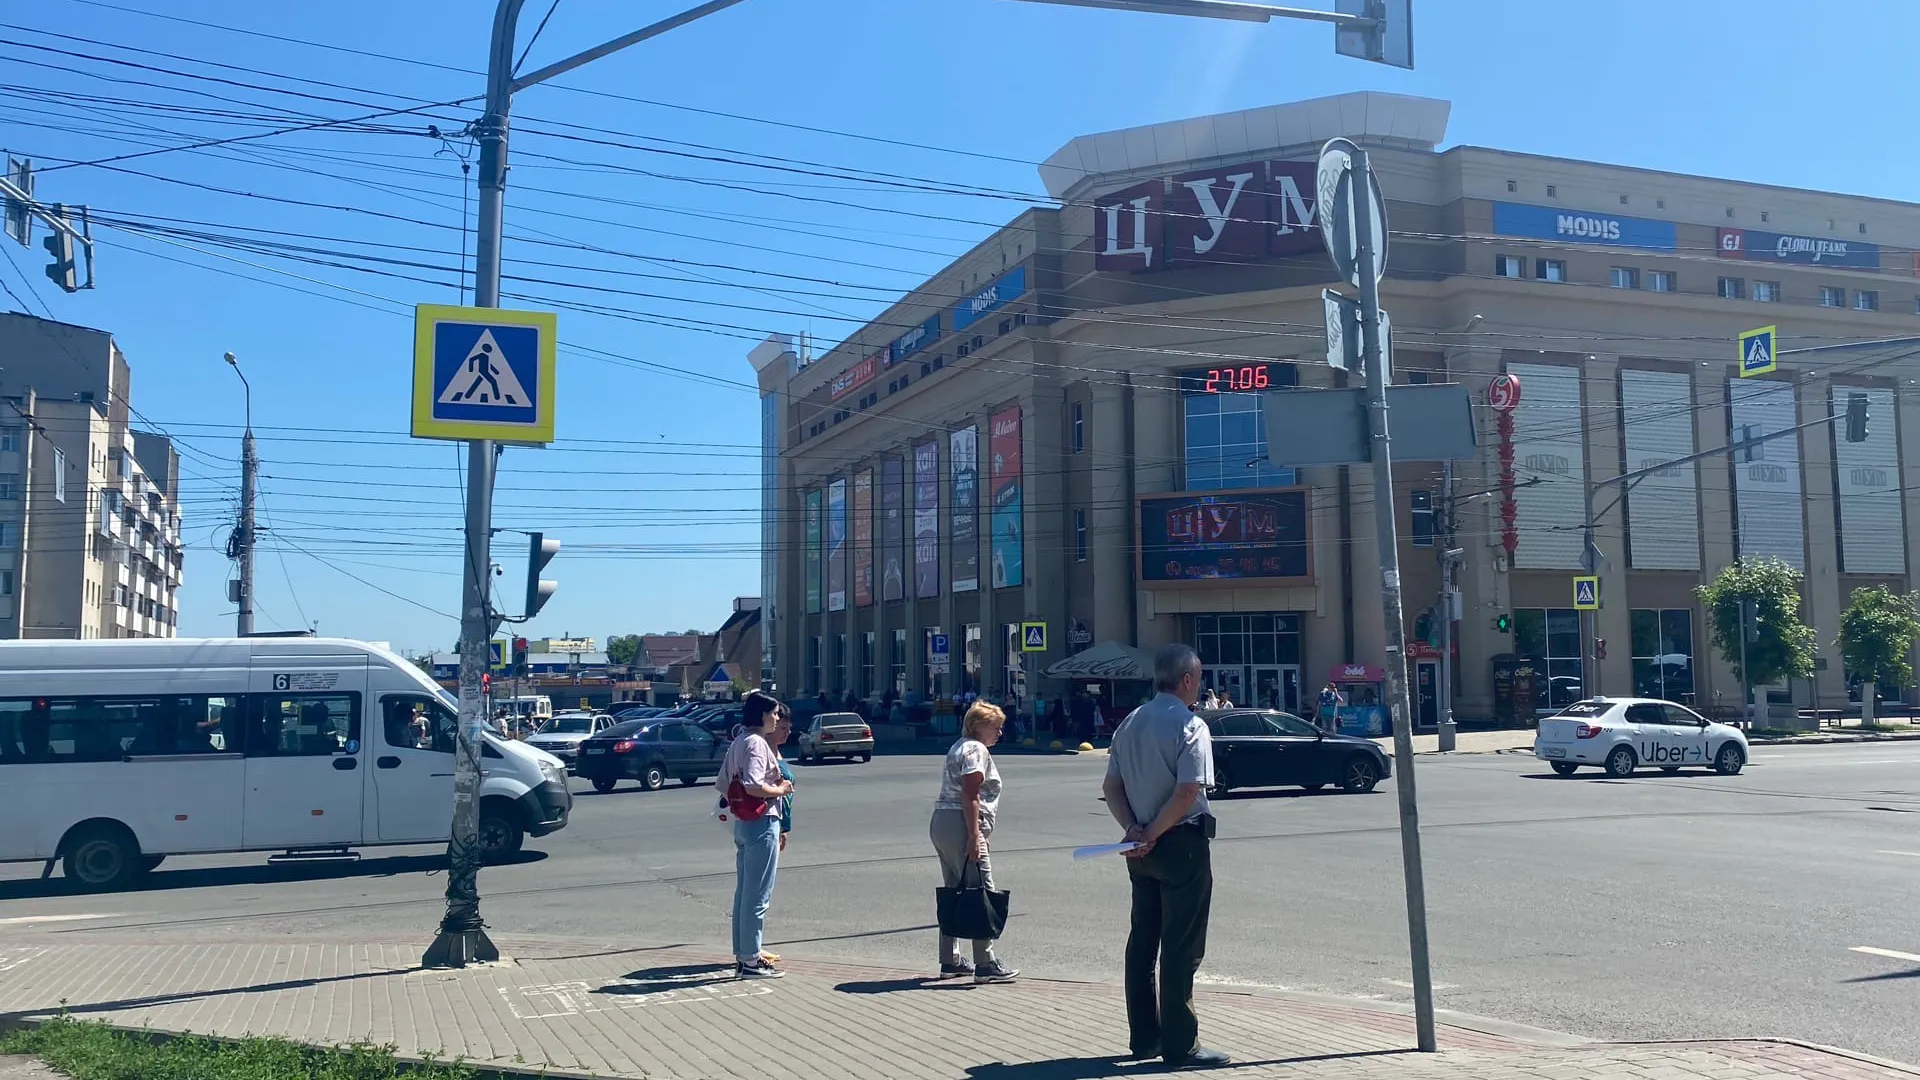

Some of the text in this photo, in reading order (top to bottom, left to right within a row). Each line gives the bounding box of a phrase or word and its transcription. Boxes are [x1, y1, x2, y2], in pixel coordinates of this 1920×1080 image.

[1101, 172, 1319, 268] ЦУМ
[1556, 214, 1621, 241] MODIS
[1721, 234, 1741, 251] GJ
[971, 286, 997, 314] MODIS
[1206, 365, 1269, 393] 27.06
[936, 635, 946, 652] P
[275, 674, 288, 690] 6
[1568, 704, 1600, 713] Uber
[1641, 740, 1689, 762] Uber
